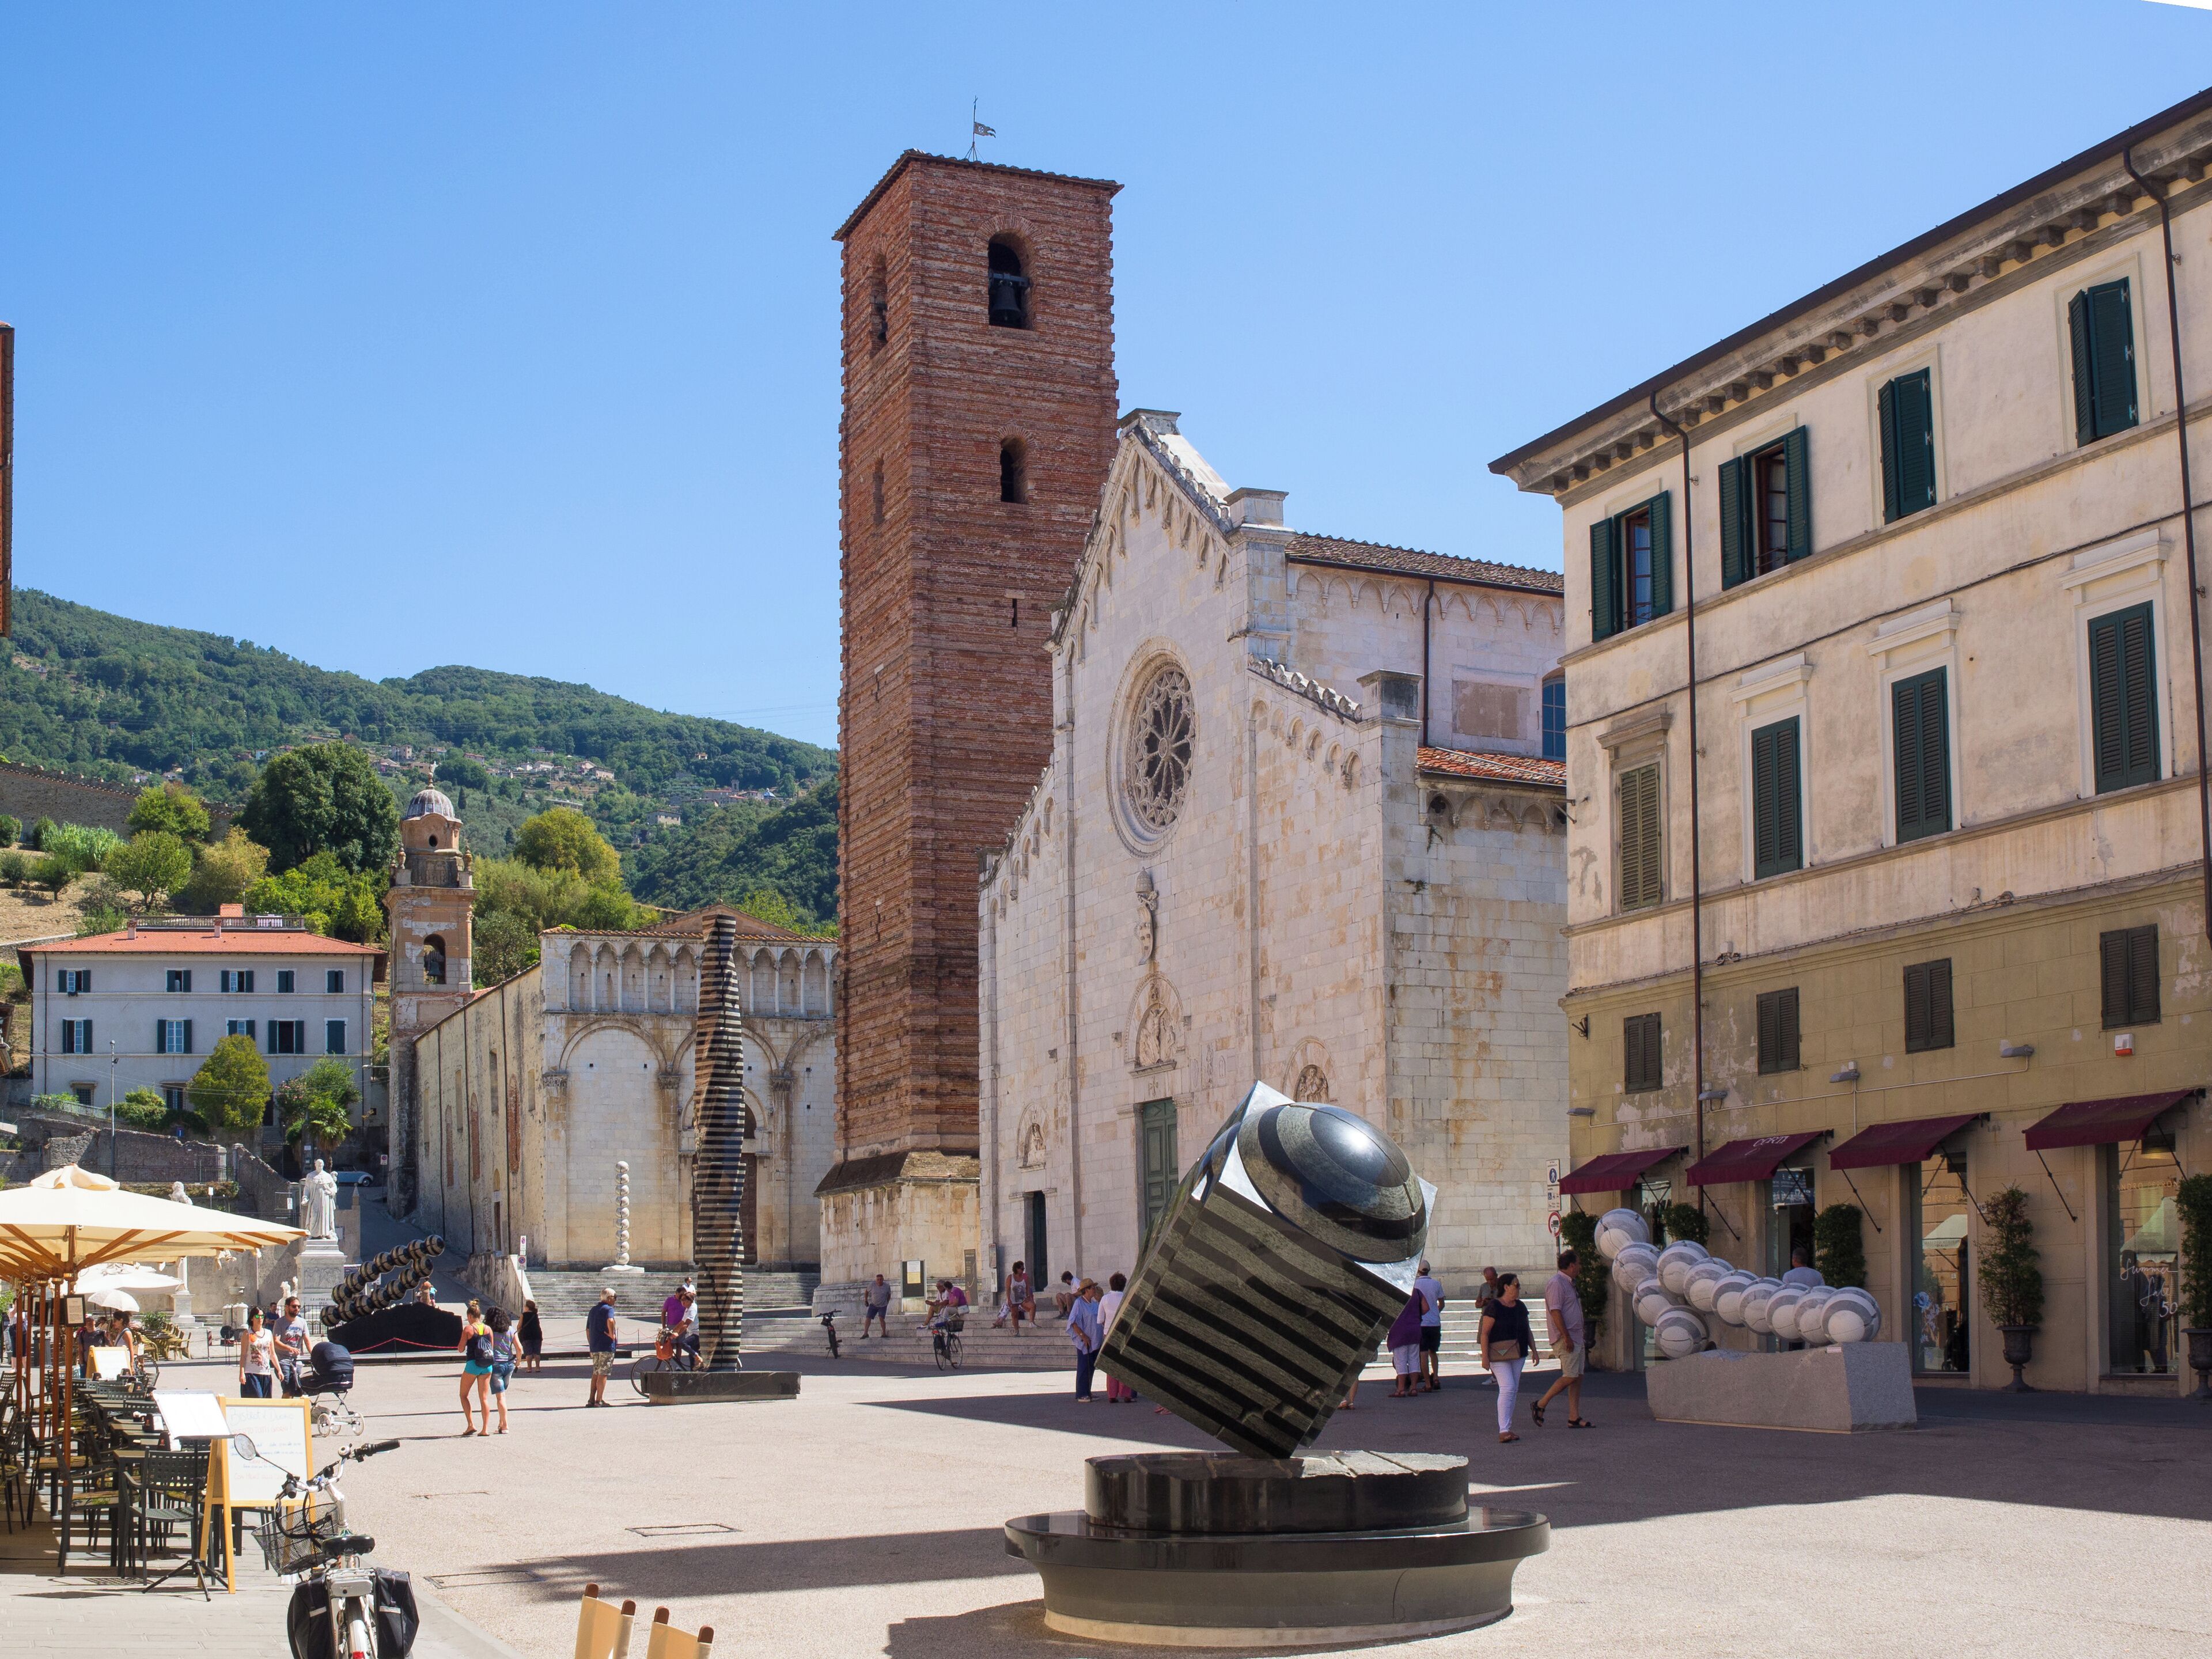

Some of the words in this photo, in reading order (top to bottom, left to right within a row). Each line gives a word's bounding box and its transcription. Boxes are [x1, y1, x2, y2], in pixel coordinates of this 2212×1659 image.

[2120, 1257, 2179, 1281] Summer
[2139, 1277, 2170, 1306] Sale
[2159, 1301, 2178, 1317] 50
